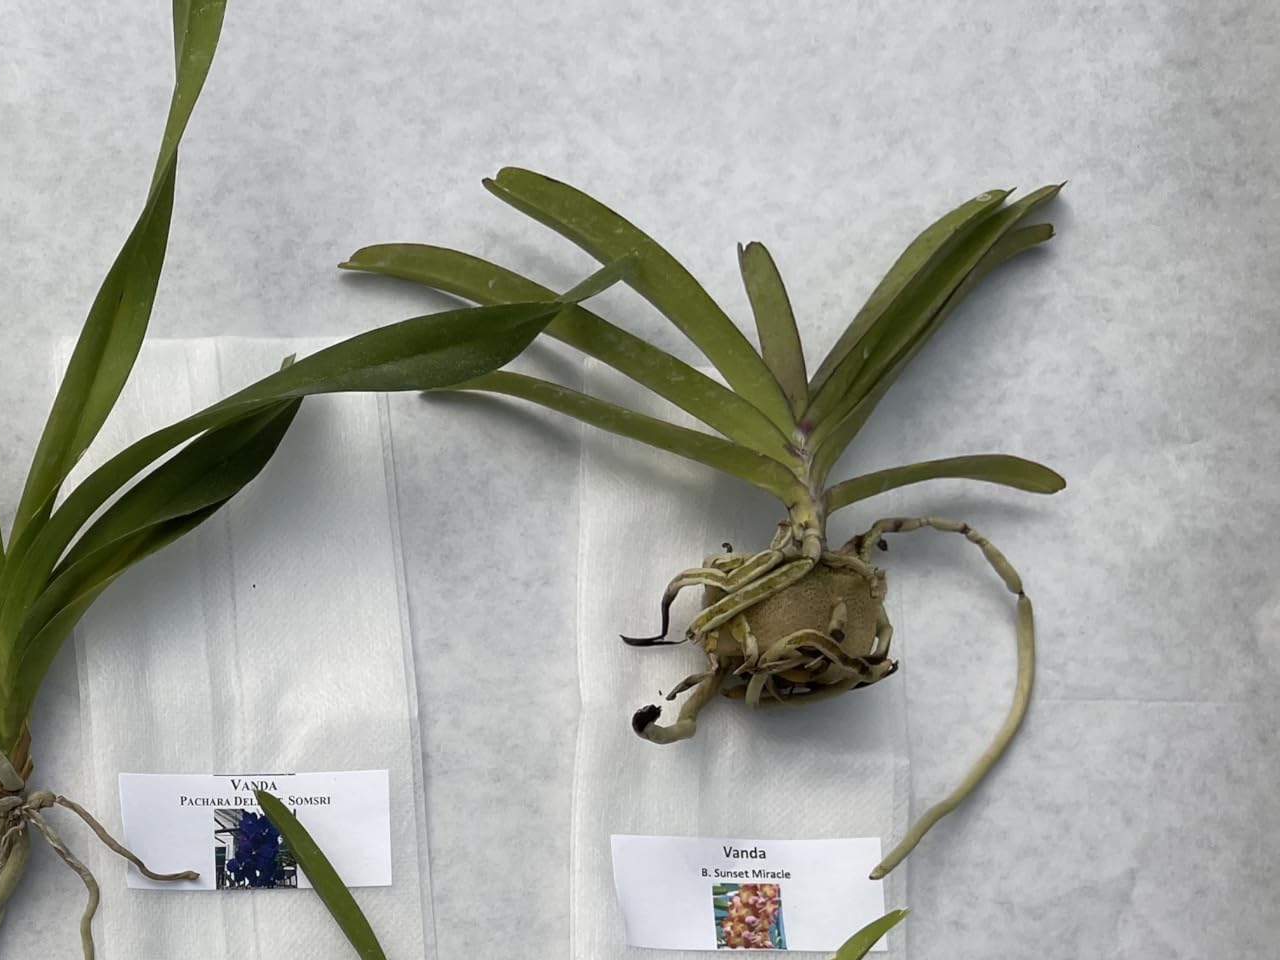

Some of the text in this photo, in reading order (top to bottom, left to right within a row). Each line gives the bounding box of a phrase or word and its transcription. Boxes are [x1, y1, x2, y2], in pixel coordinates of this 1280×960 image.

[231, 779, 277, 791] VANDA
[180, 796, 231, 806] PACHARA
[288, 796, 331, 806] SOMSRI
[723, 846, 767, 859] Vanda
[701, 868, 792, 879] B. Sunset Miracle
